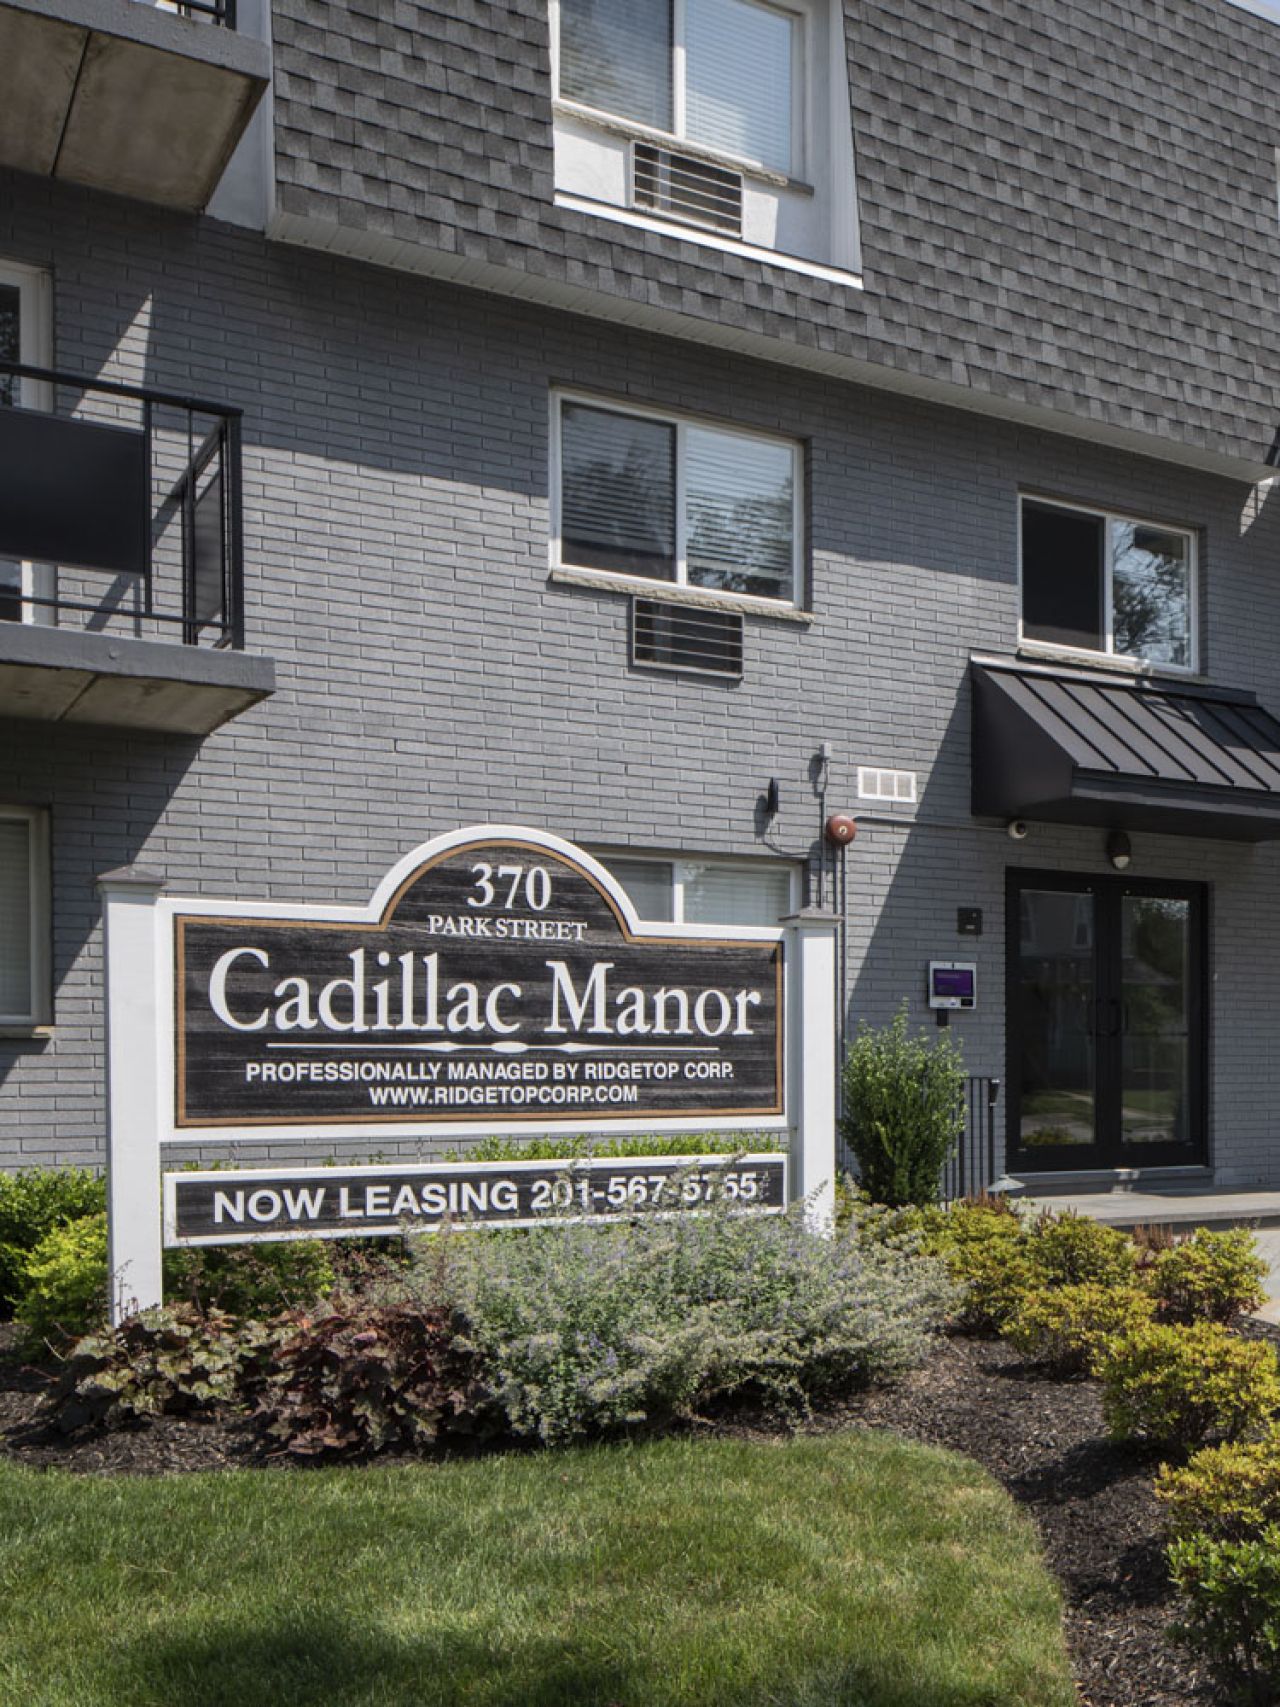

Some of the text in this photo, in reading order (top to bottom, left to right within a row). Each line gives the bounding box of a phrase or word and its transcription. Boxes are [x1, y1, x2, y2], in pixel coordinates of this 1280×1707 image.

[467, 863, 552, 911] 370
[428, 915, 588, 940] PARK STREET
[209, 947, 762, 1037] Cadillac Manor
[246, 1062, 735, 1082] PROFESSIONALLY MANAGED BY RIDGETOP CORP.
[368, 1084, 639, 1105] WWW.RIDGETOPCORP.COM
[214, 1187, 326, 1223] NOW
[339, 1180, 519, 1218] LEASING
